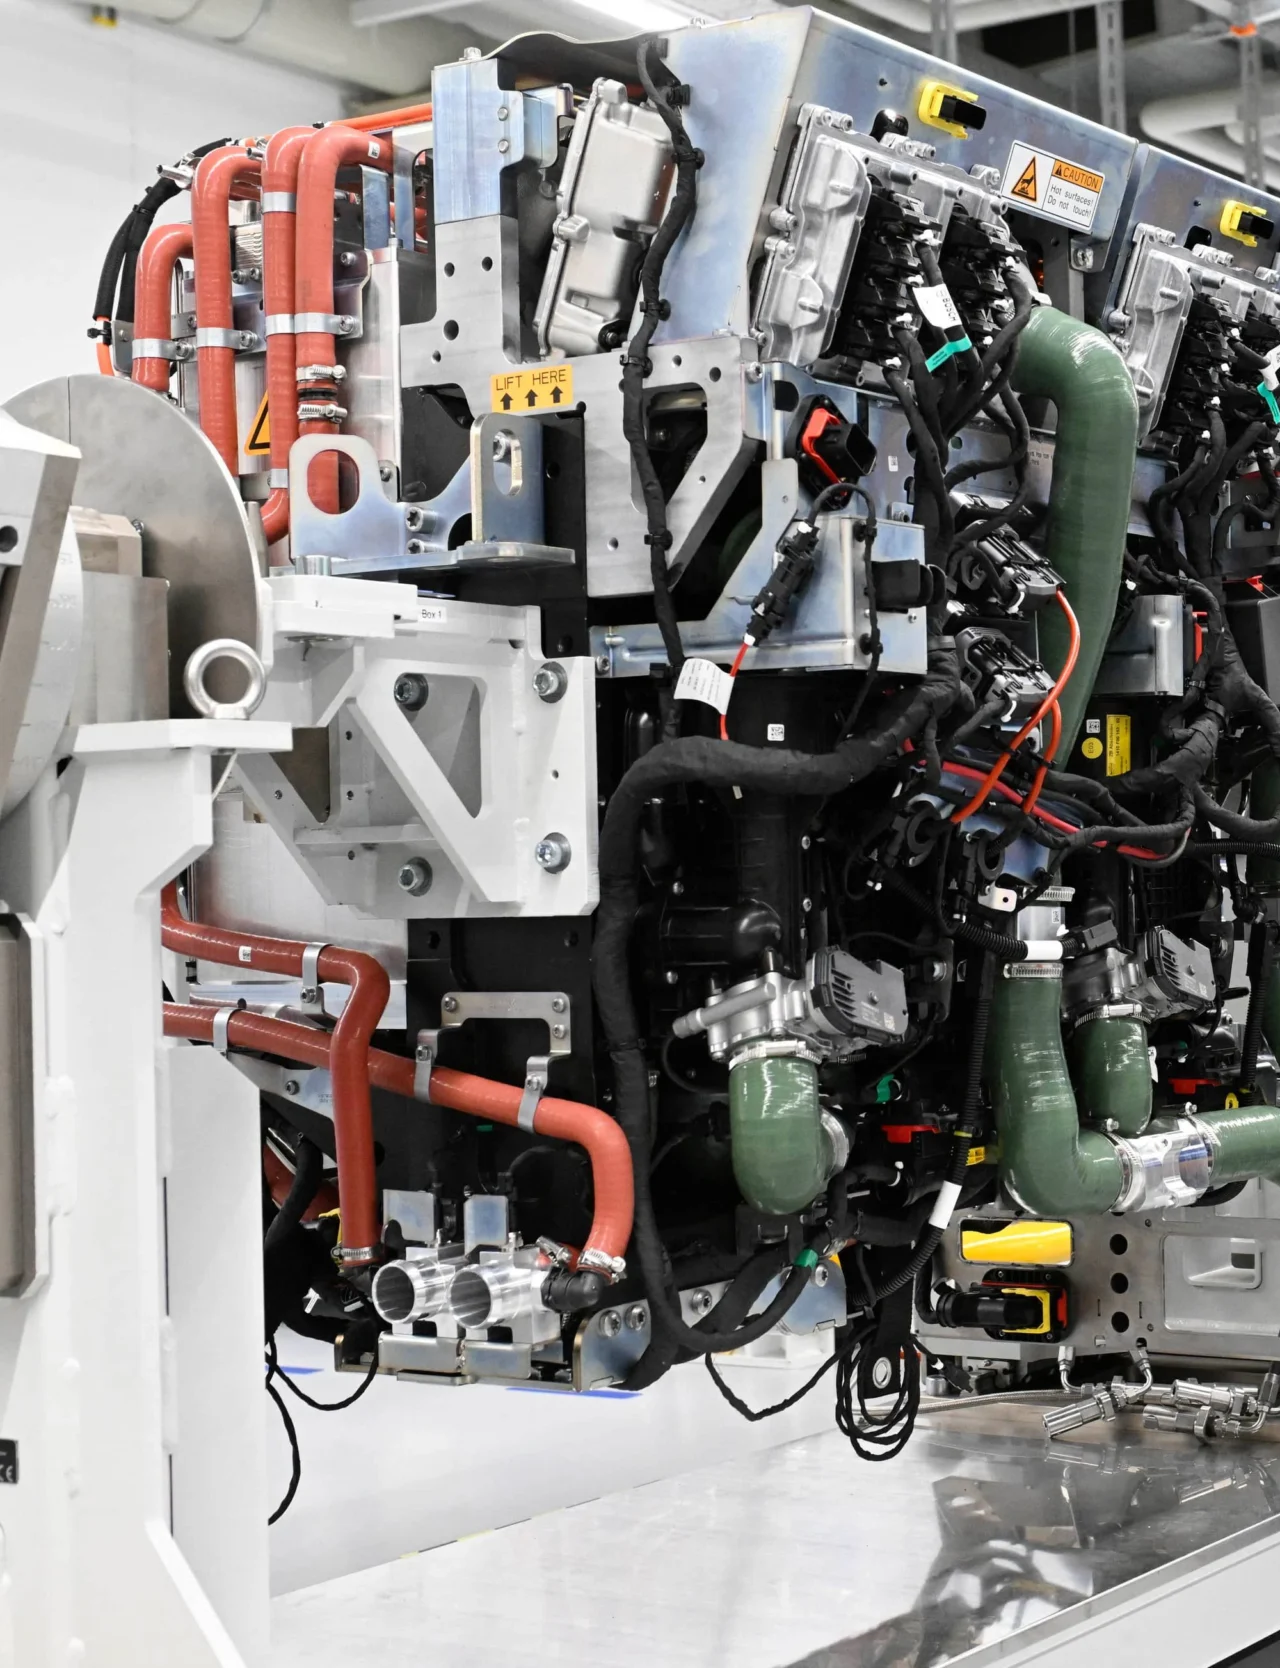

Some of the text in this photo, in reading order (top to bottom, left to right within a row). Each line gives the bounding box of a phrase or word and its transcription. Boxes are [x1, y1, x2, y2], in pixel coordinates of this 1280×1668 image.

[1063, 167, 1099, 189] CAUTION
[1047, 195, 1092, 218] Do not touch!
[1051, 185, 1094, 207] Hot surfaces!
[943, 298, 957, 322] BOSCH
[495, 368, 567, 391] LIFT HERE
[421, 608, 442, 619] Box 1
